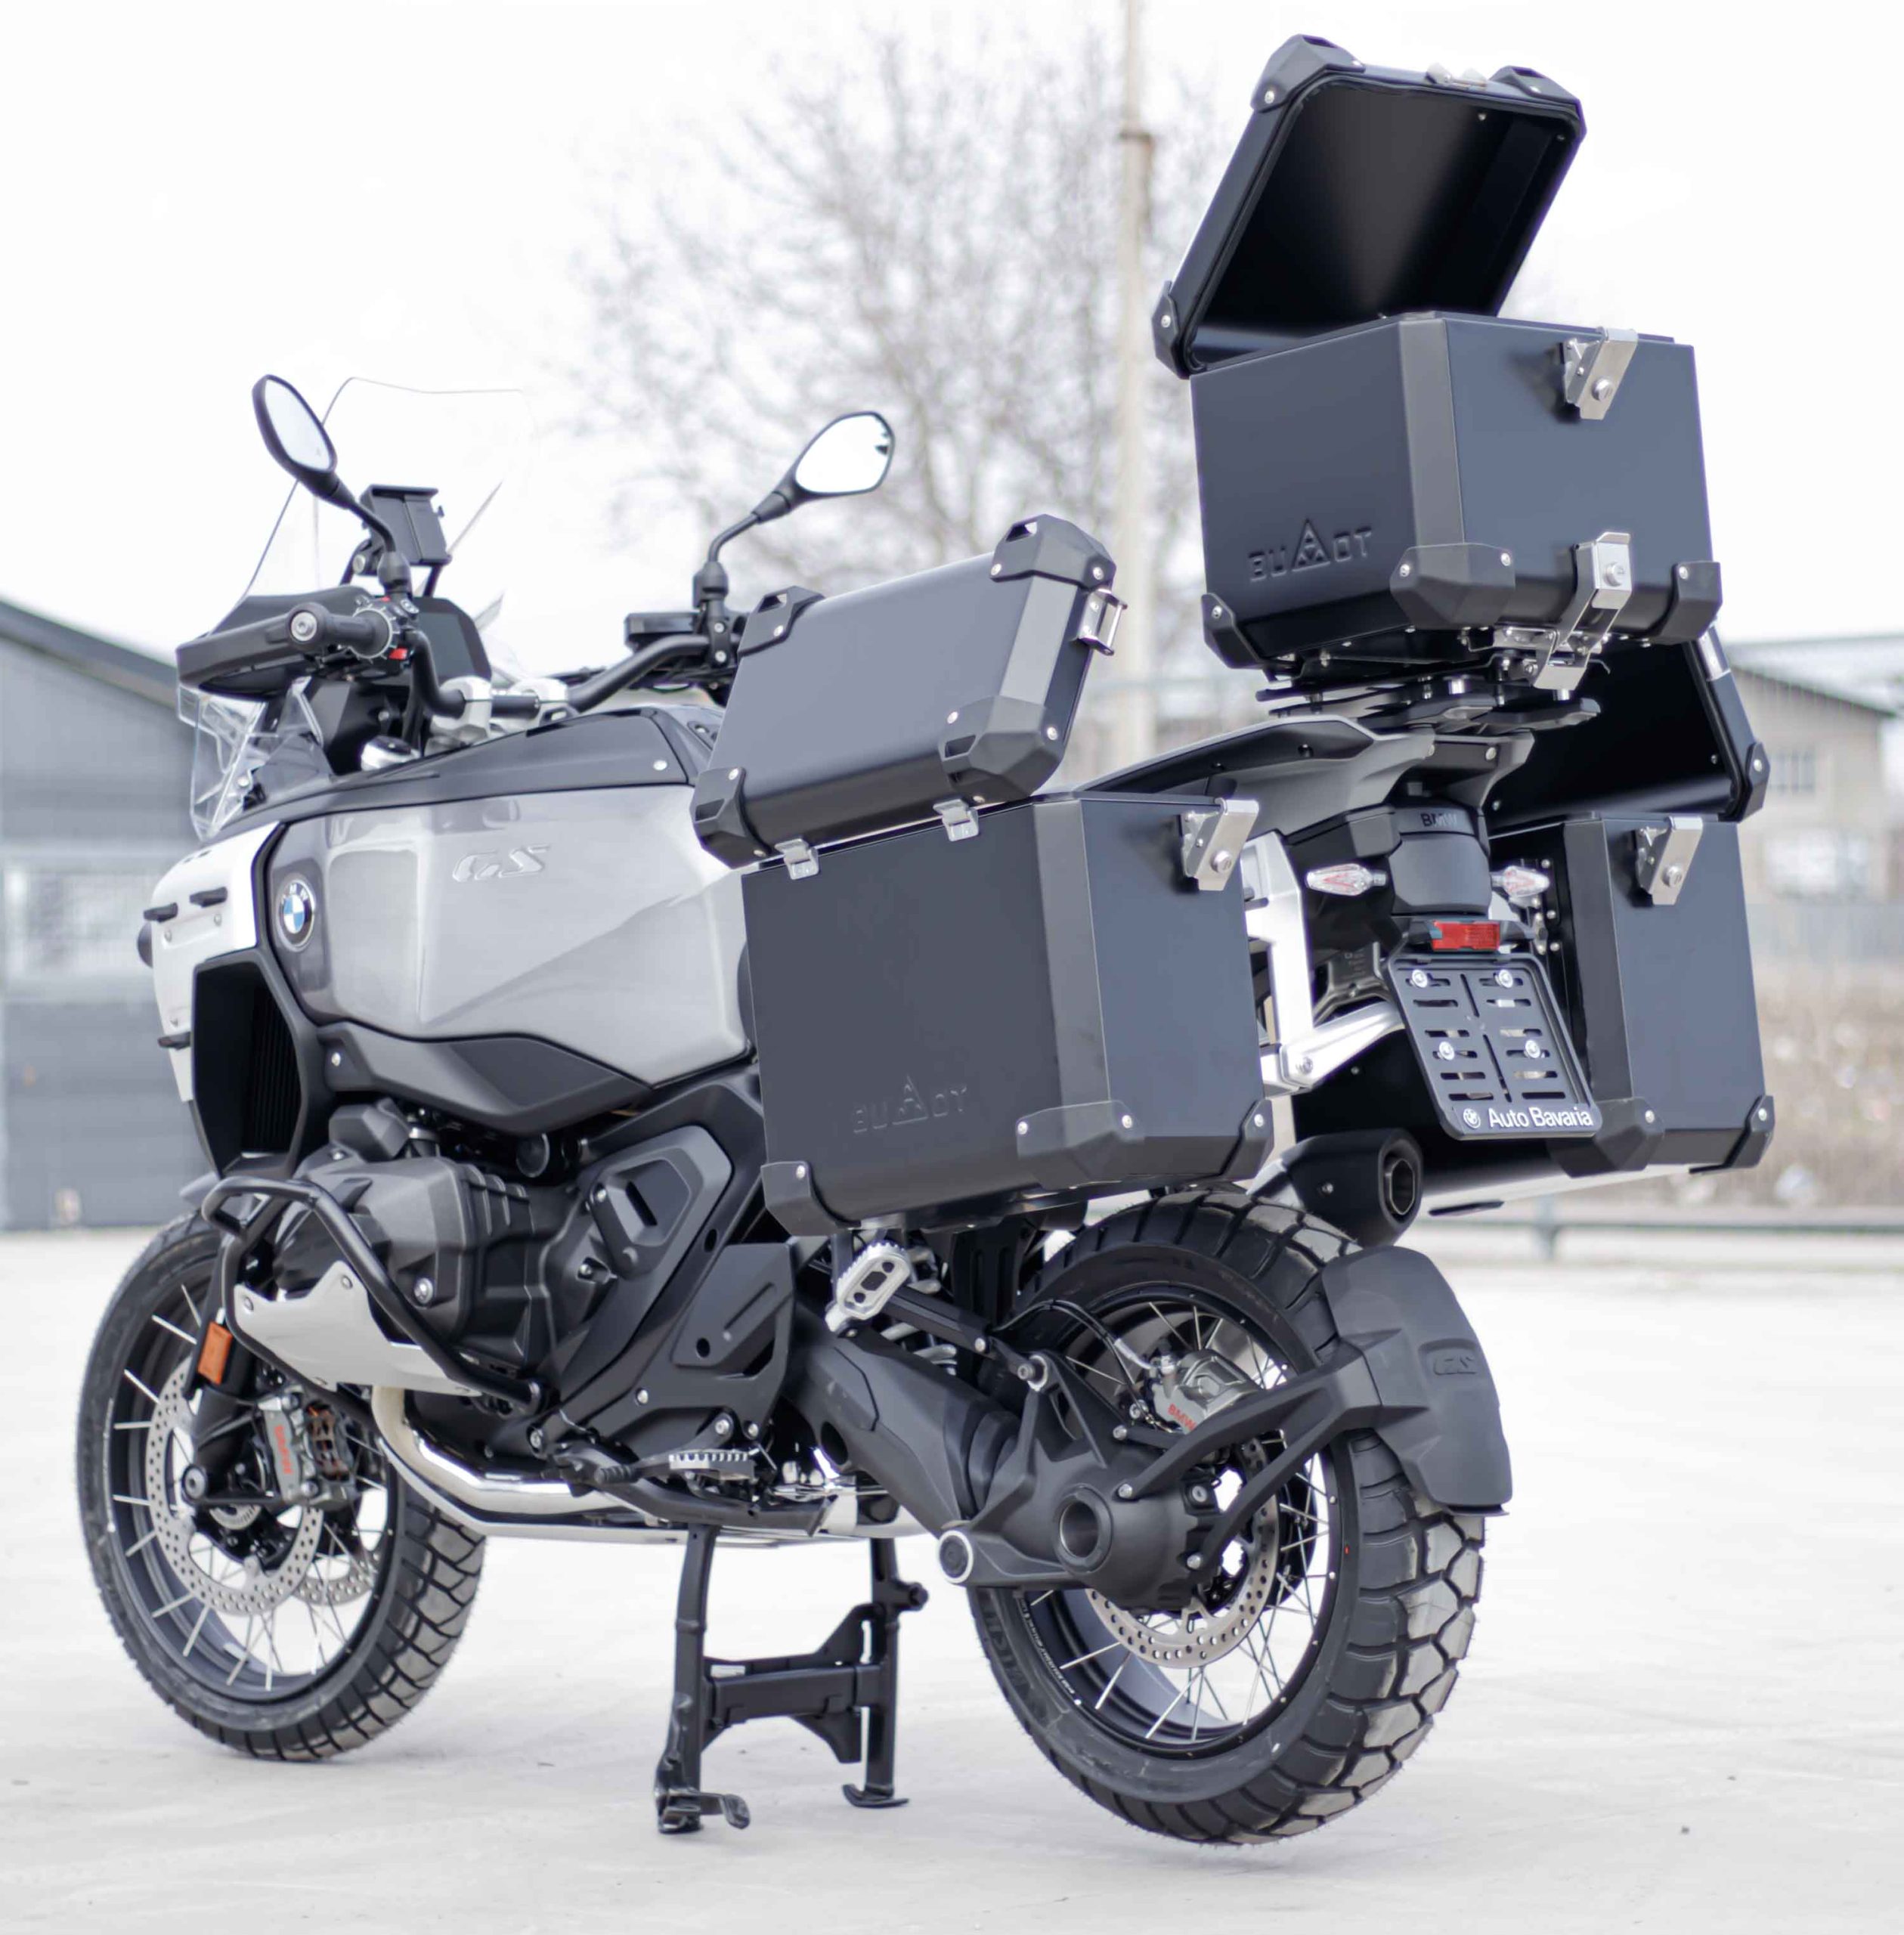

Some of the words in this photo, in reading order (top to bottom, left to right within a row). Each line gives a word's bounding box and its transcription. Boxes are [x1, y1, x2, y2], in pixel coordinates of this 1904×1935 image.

[1420, 812, 1457, 828] BMW
[452, 844, 550, 882] GS
[1488, 1107, 1529, 1128] Auto
[1528, 1106, 1594, 1127] Bavaria
[1167, 1403, 1197, 1431] BMW
